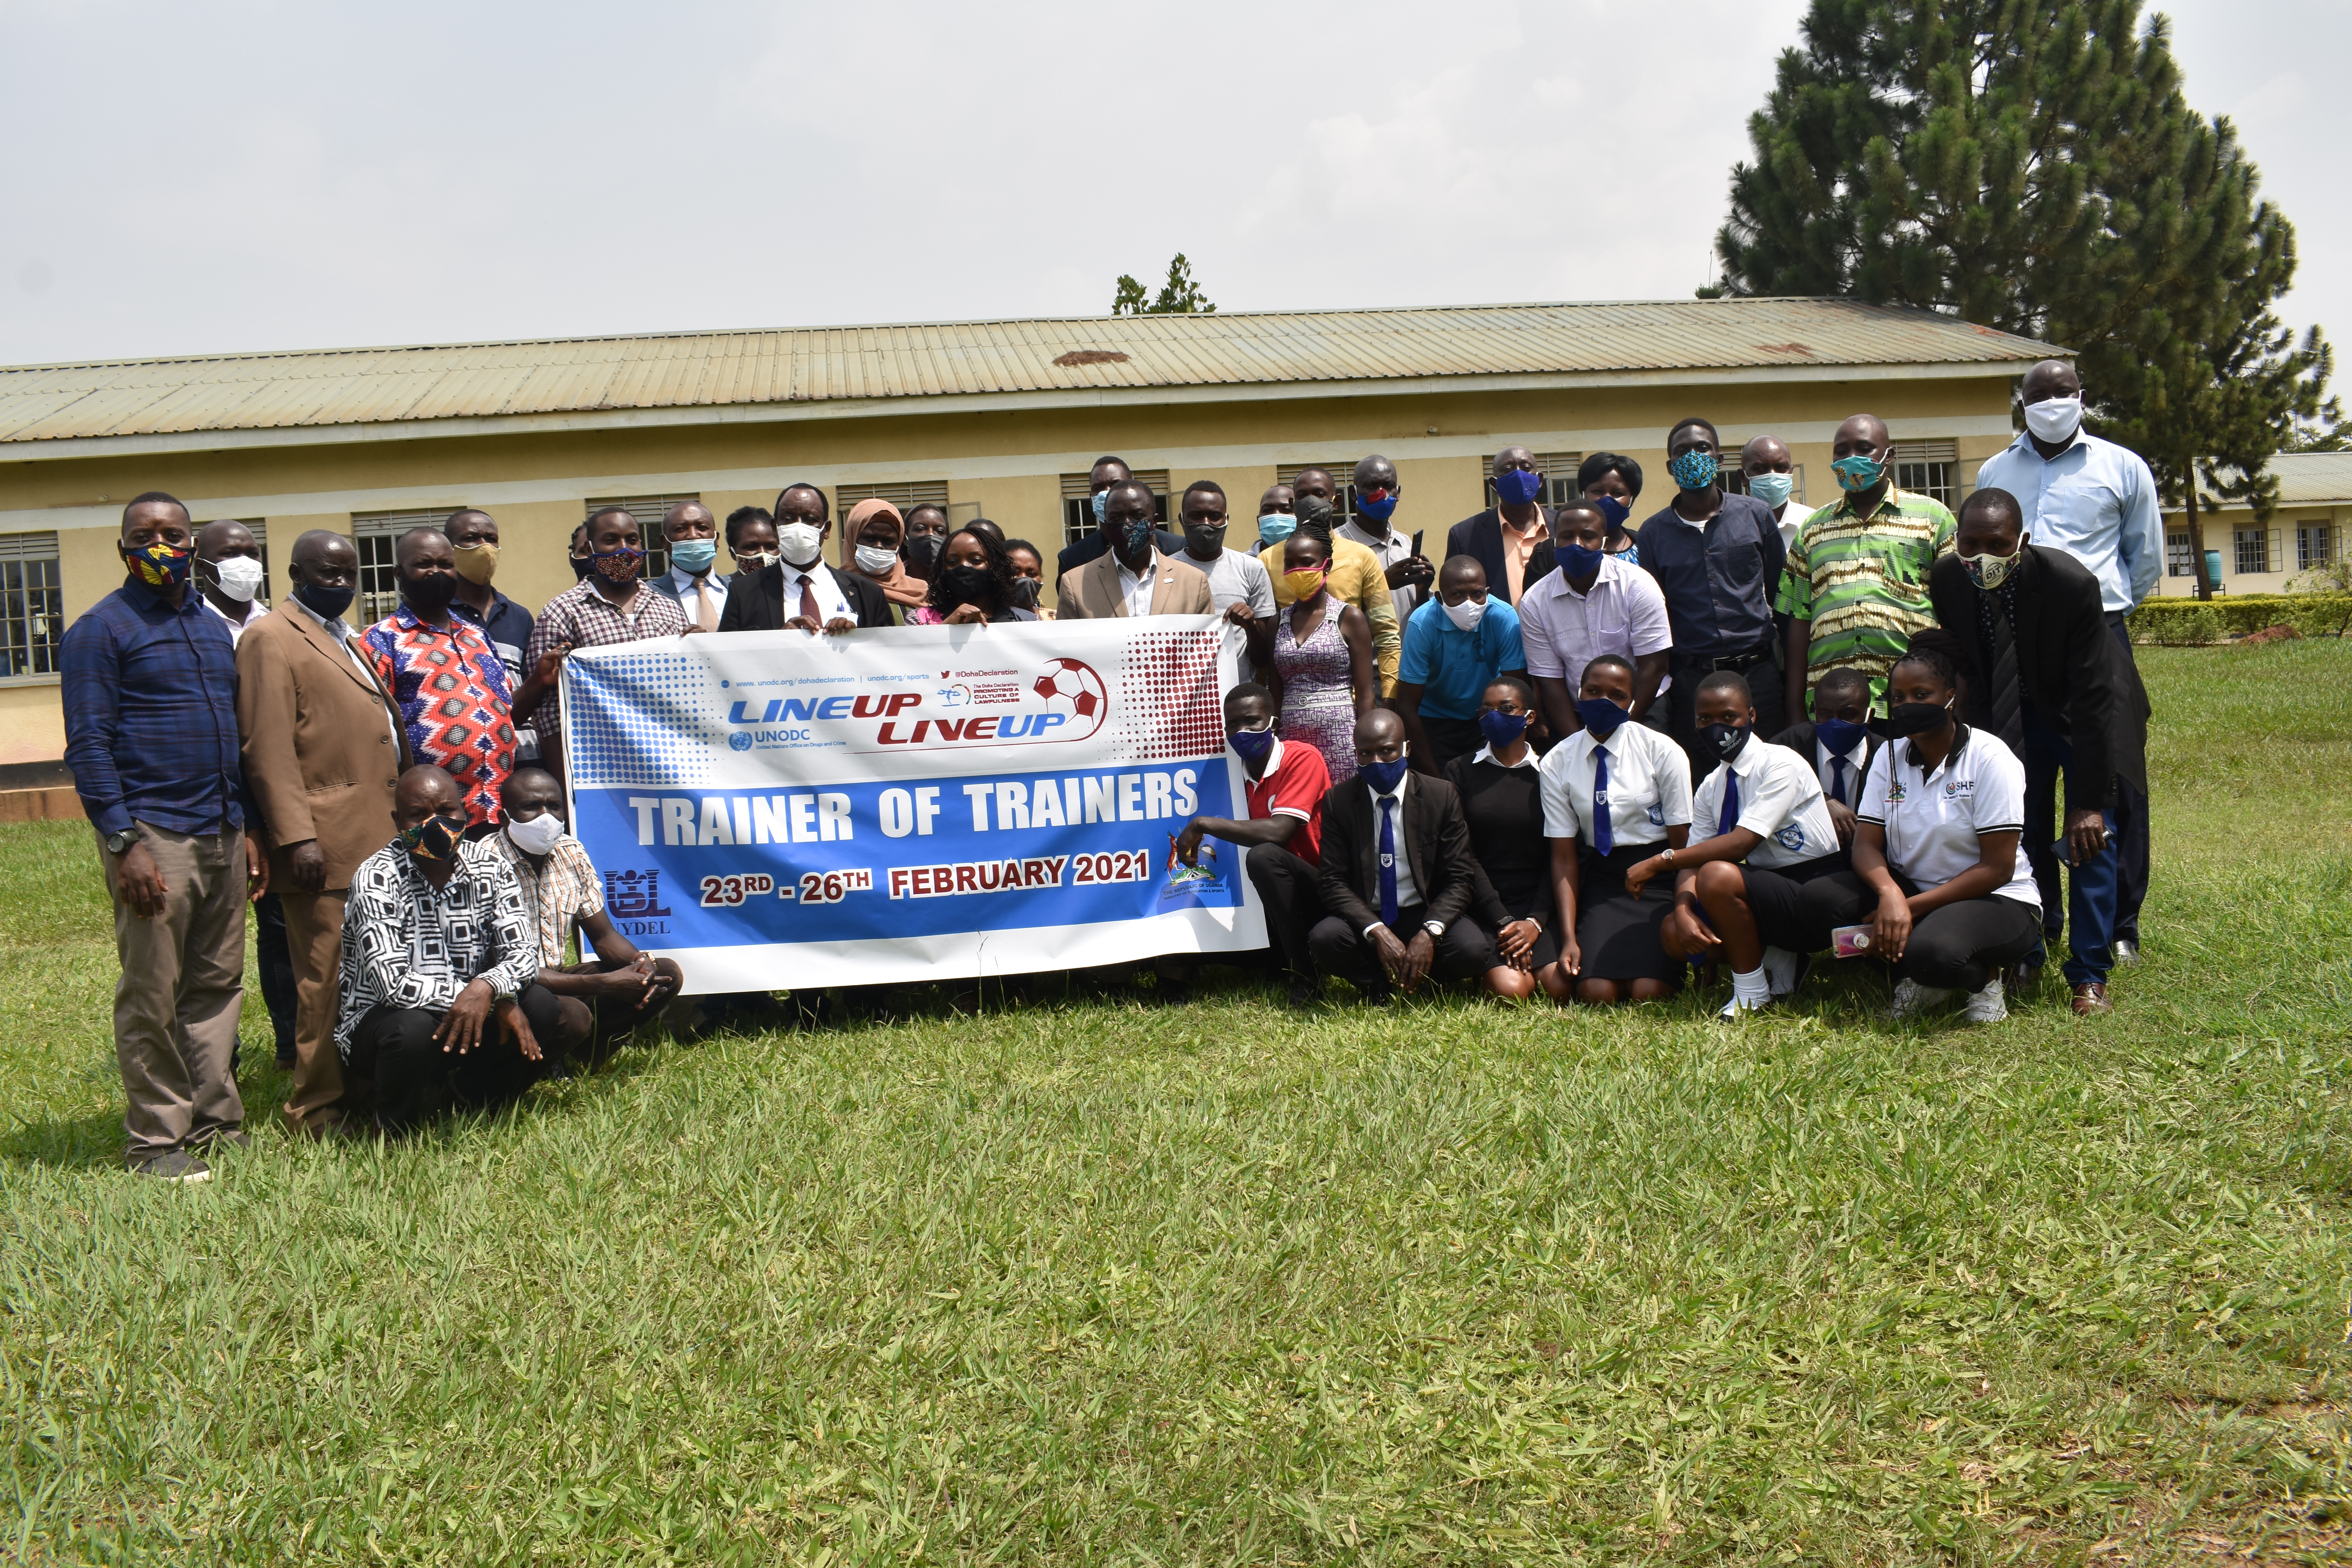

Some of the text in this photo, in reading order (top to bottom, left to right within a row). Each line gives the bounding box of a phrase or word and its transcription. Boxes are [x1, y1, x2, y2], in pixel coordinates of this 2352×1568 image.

[1986, 566, 2001, 579] DIT
[955, 669, 1018, 677] @DohaDeclaration
[758, 677, 855, 686] unodc.org/dohadeclaration
[728, 693, 922, 724] LINEUP
[755, 729, 810, 742] UNODC
[877, 713, 1065, 744] LIVEUP
[1722, 738, 1742, 754] adidas
[629, 769, 1198, 846] TRAINER OF TRAINERS
[702, 875, 773, 906] 23RD
[801, 870, 871, 902] 26TH
[890, 856, 1068, 898] FEBRUARY
[1074, 850, 1148, 884] 2021
[1174, 884, 1198, 893] REPUBLIC
